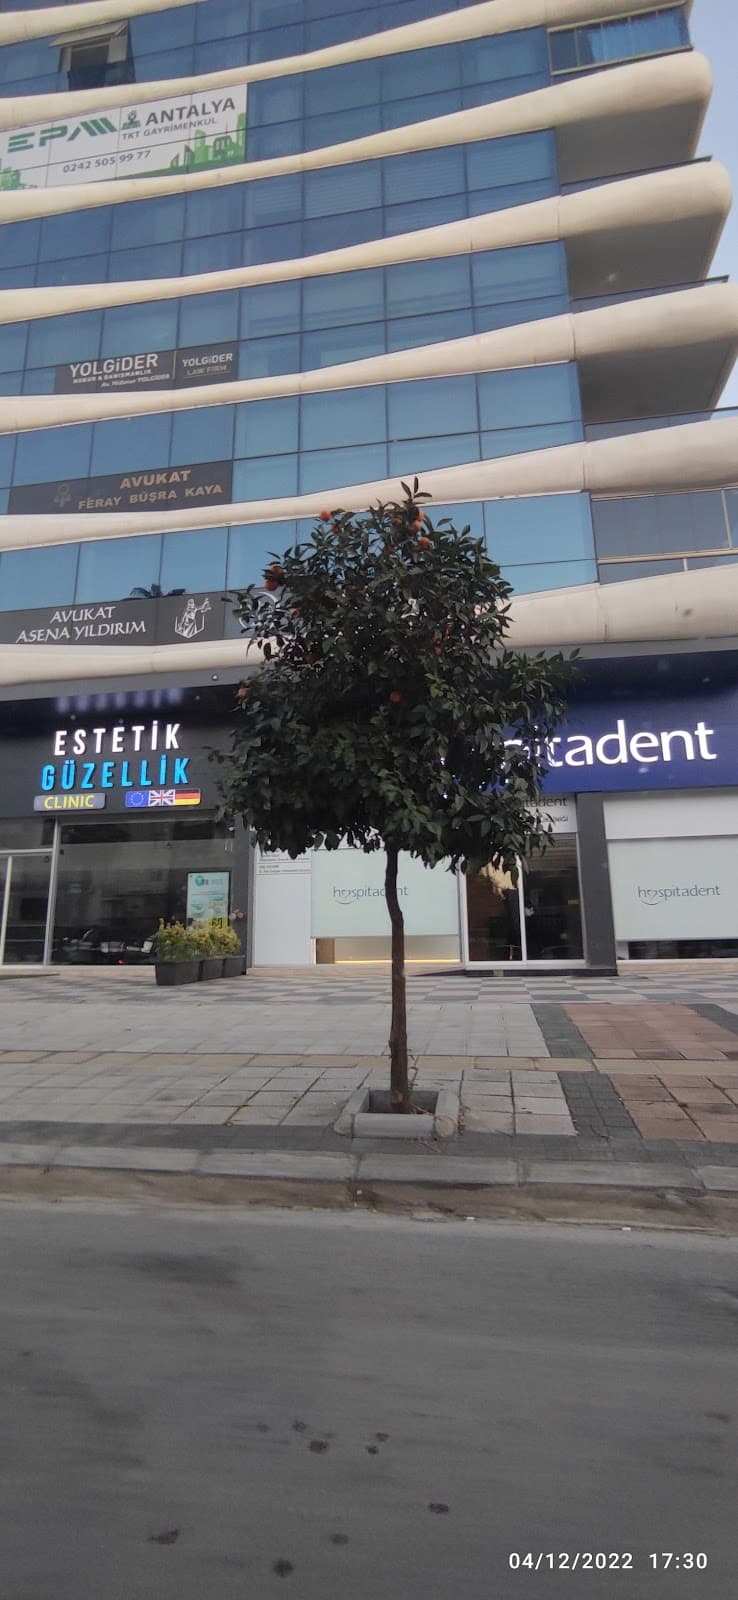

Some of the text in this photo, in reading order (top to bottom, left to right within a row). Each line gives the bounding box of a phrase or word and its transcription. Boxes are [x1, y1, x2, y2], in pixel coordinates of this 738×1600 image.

[145, 97, 235, 126] ANTALYA
[122, 130, 140, 140] TKT
[63, 150, 151, 173] 0242 505 99 77
[120, 470, 191, 489] AVUKAT
[78, 496, 122, 510] FERAY
[185, 484, 223, 497] KAYA
[50, 606, 116, 624] AVUKAT
[16, 620, 146, 643] ASENA YILDIRIM
[54, 720, 180, 756] ESTETİK
[41, 754, 190, 791] GÜZELLİK
[44, 794, 95, 810] CLINIC
[637, 885, 721, 901] hospitadent
